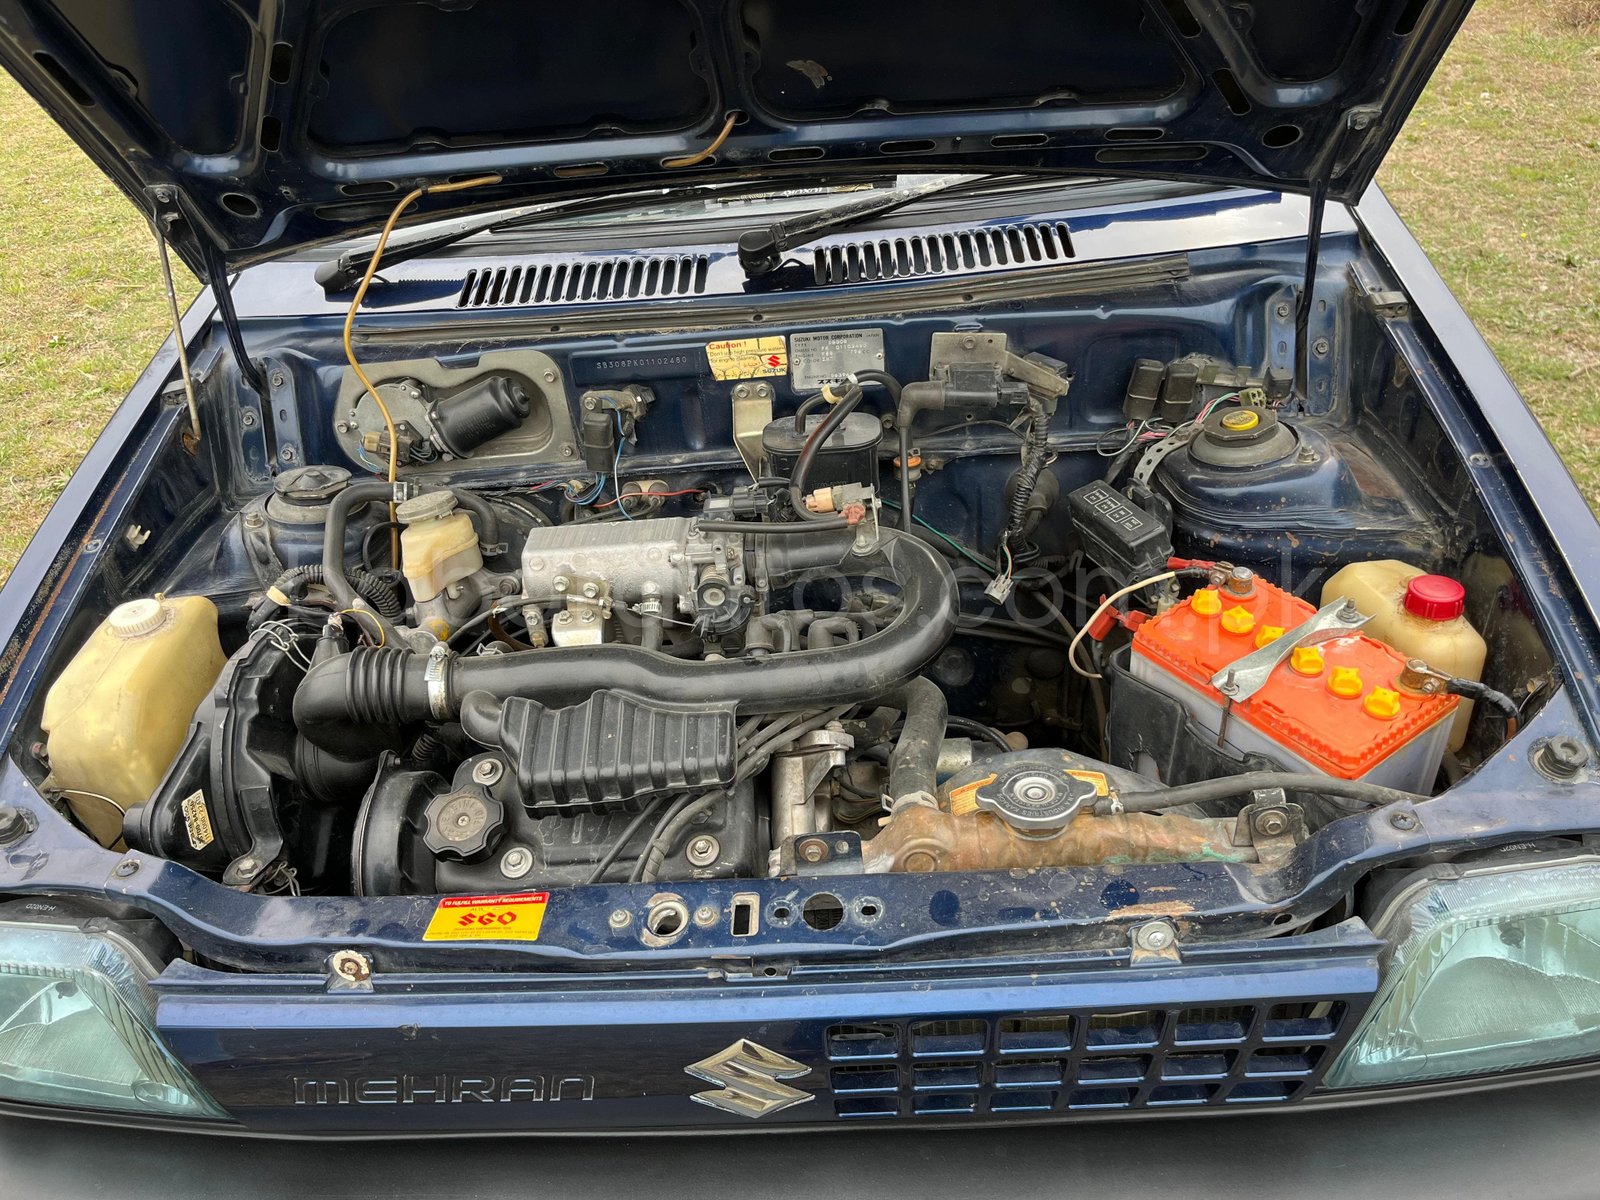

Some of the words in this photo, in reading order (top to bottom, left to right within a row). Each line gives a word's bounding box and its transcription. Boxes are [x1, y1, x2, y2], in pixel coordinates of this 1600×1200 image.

[501, 896, 543, 904] REQUIREMENTS
[457, 911, 517, 927] SGO
[293, 1074, 595, 1104] MEHRAN
